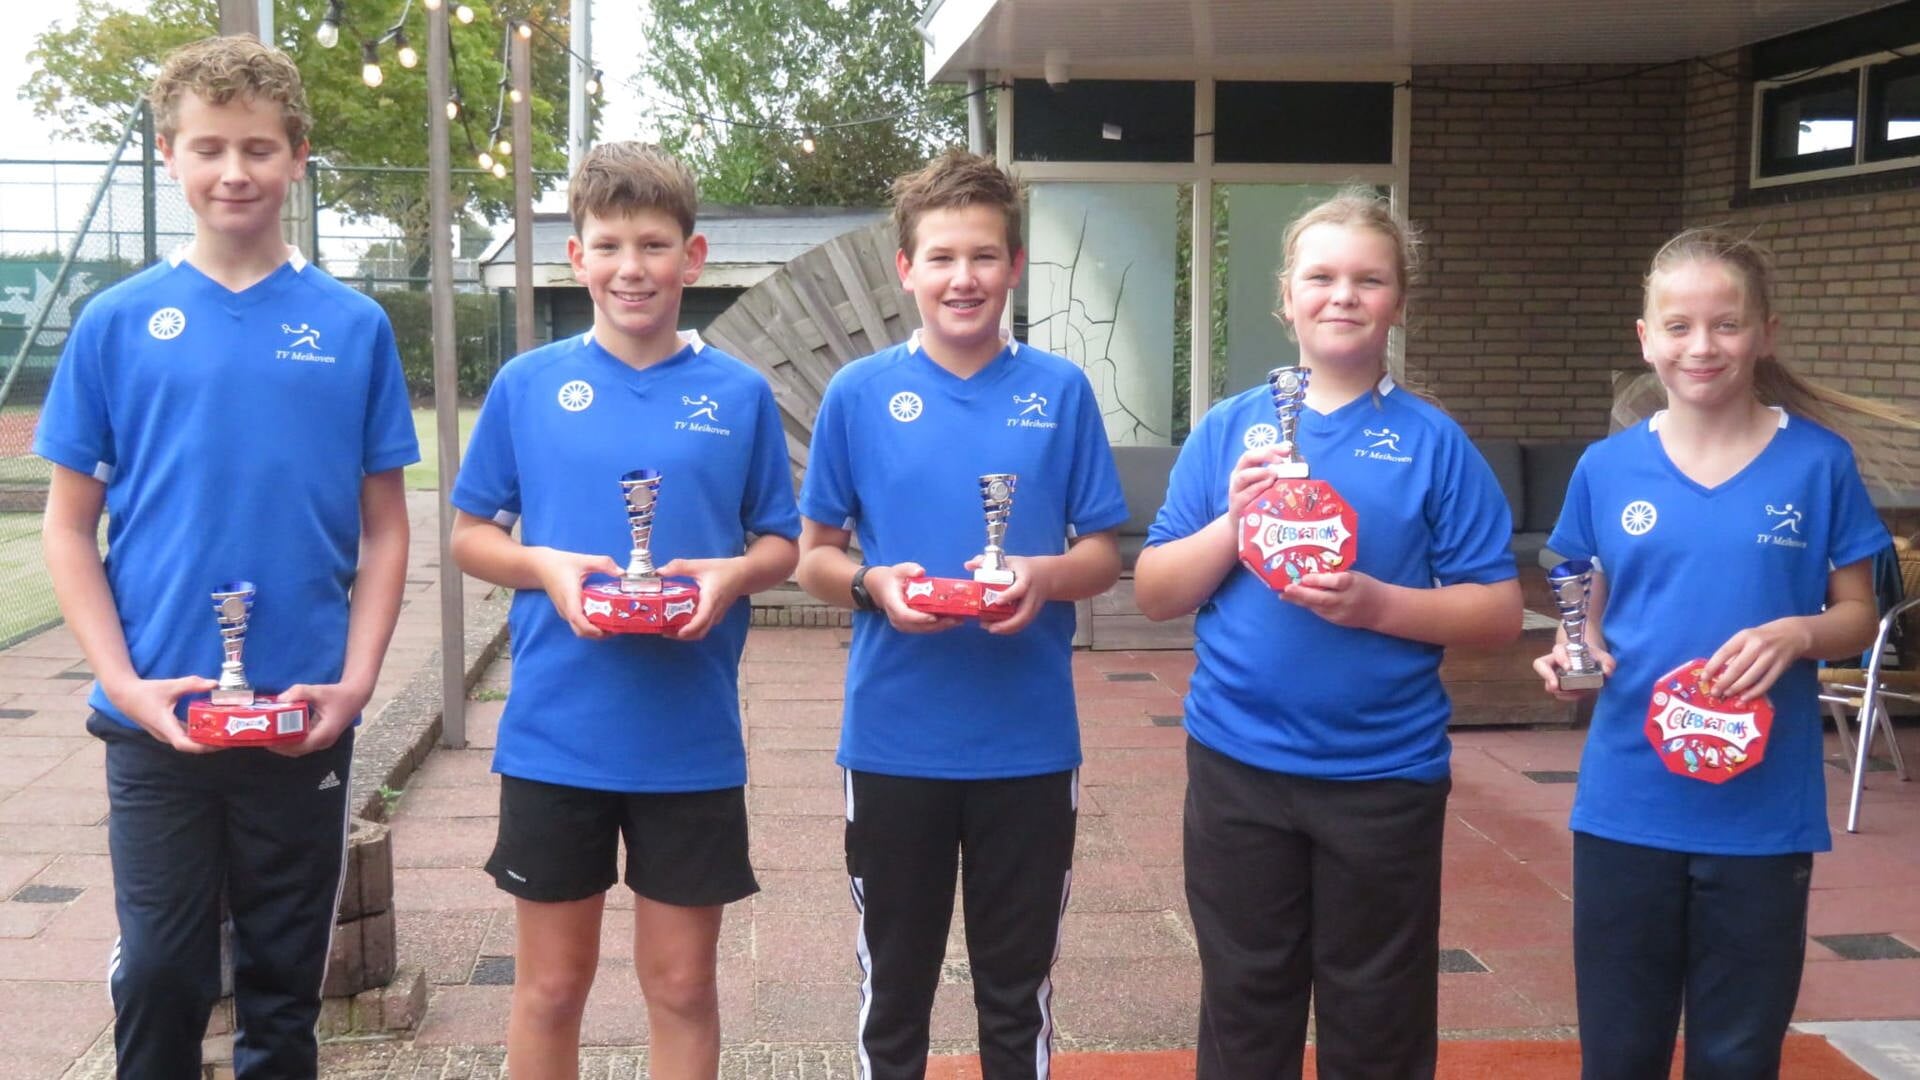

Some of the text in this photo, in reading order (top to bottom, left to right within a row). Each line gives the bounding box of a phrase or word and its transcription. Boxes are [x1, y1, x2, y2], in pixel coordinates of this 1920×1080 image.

[276, 351, 335, 364] TV Meihoven
[1007, 418, 1020, 427] TV
[674, 421, 730, 437] TV Meihoven
[1353, 448, 1369, 457] TV
[1757, 534, 1772, 544] TV
